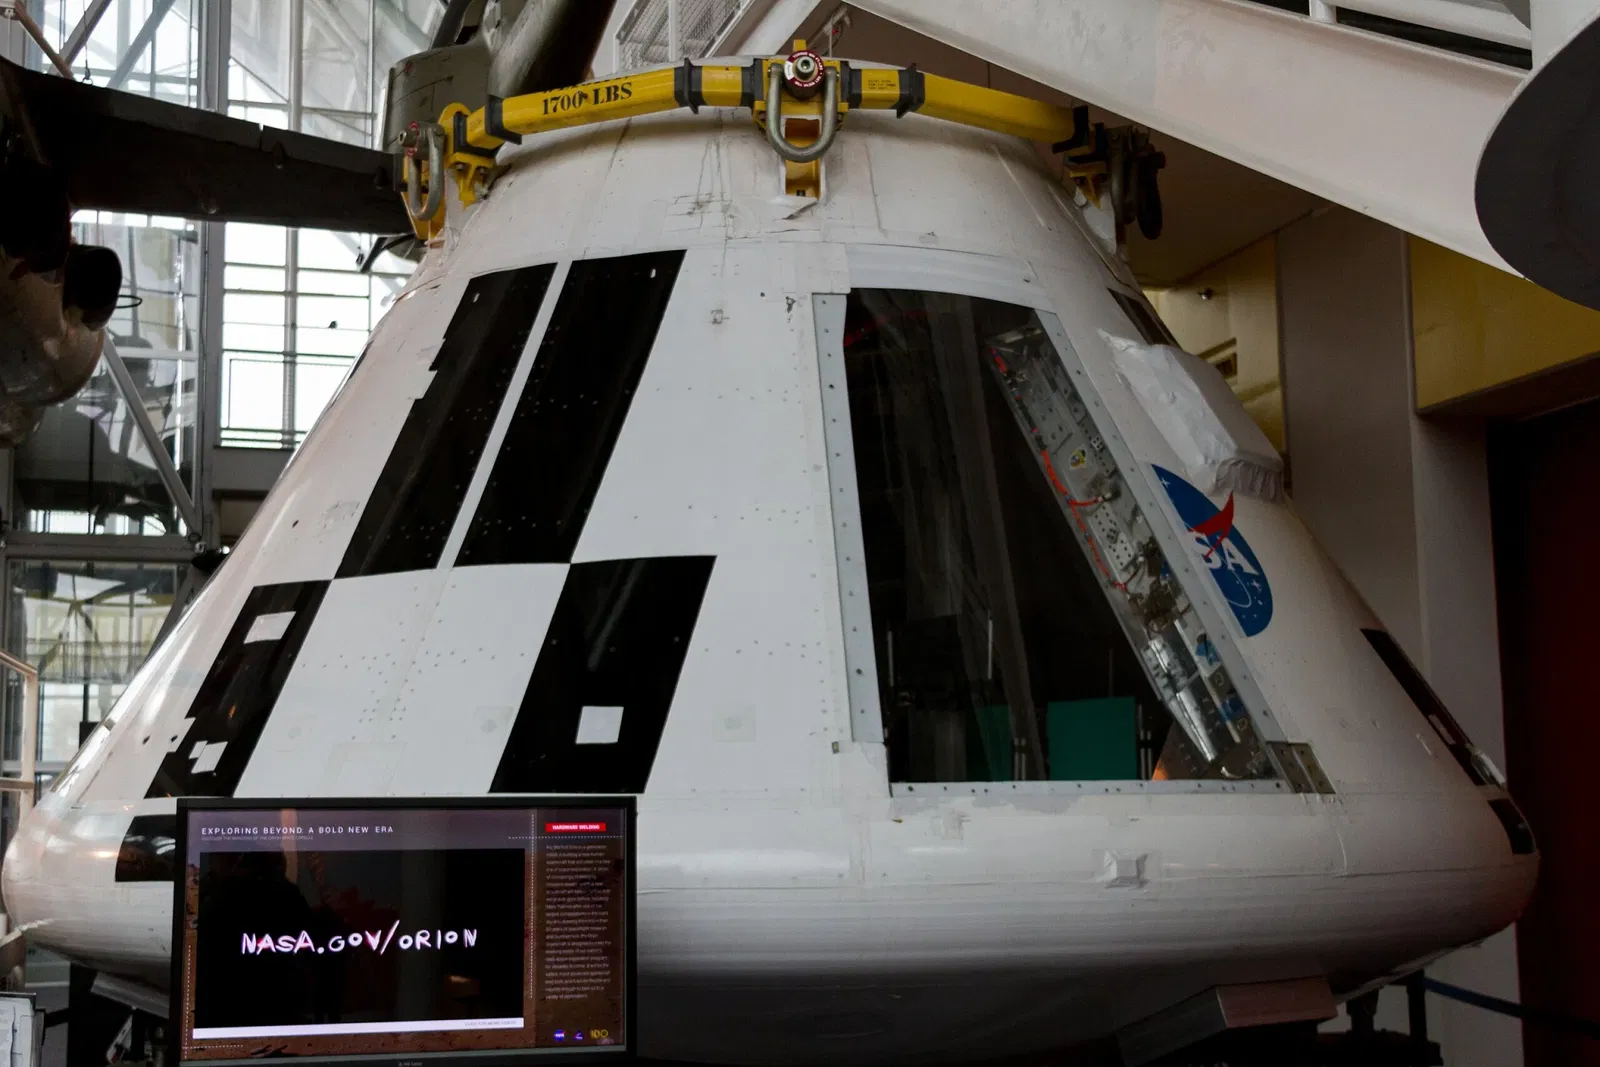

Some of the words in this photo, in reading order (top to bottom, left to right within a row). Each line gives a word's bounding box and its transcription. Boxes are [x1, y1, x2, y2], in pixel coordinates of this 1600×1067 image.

[543, 90, 583, 115] 1700
[592, 82, 632, 105] LBS
[201, 827, 258, 835] EXPLORING
